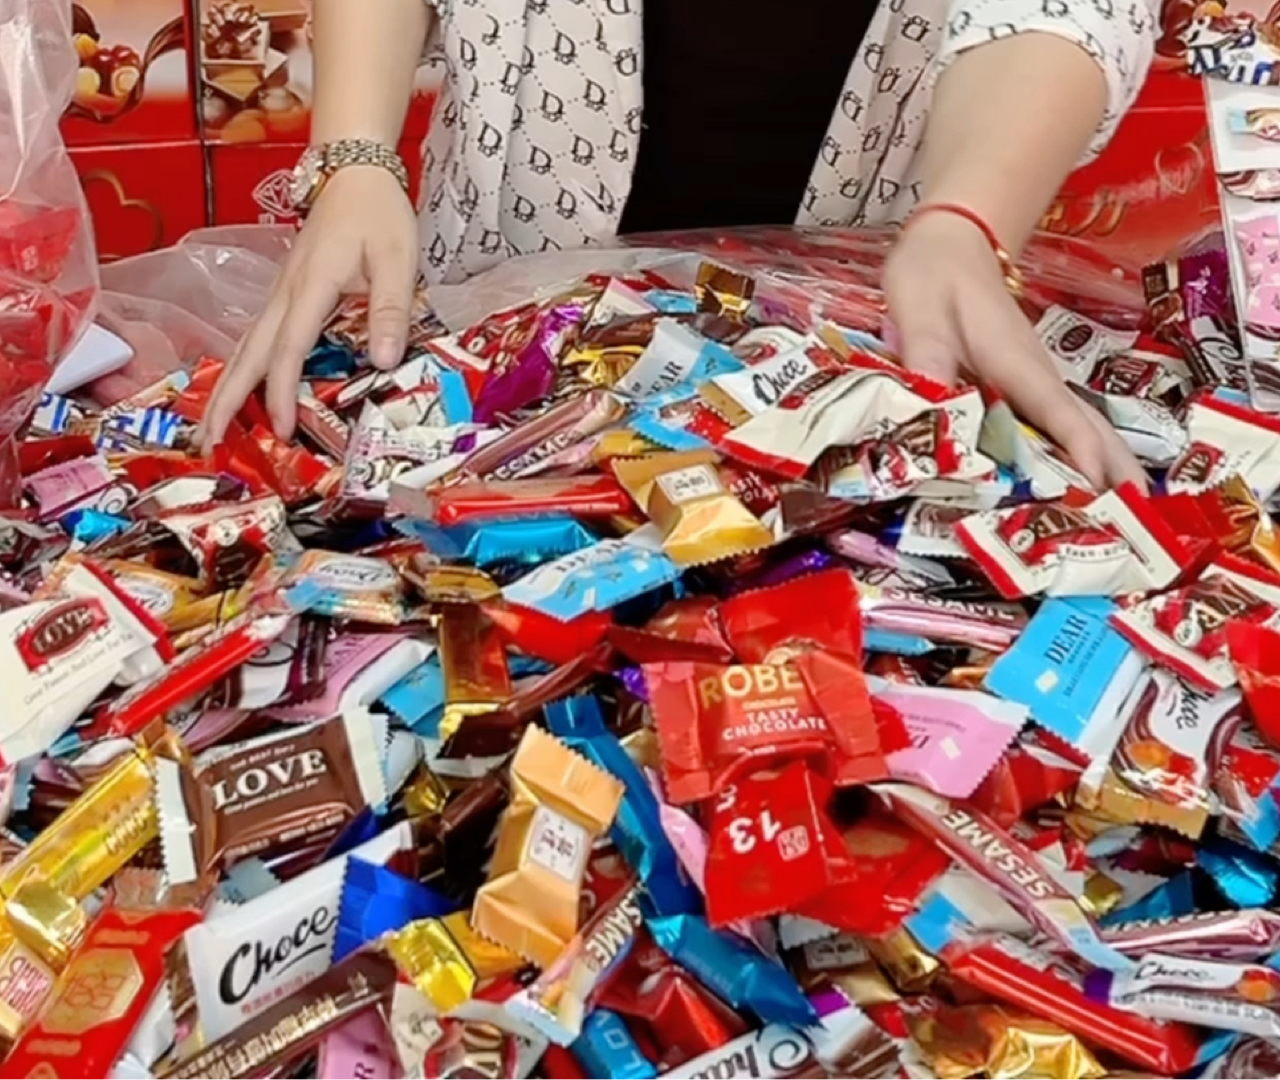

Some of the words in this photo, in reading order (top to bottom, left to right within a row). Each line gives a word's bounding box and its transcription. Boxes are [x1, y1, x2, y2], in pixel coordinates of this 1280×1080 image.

[1043, 614, 1088, 667] DEAR
[722, 718, 826, 742] CHOCOLATE
[746, 707, 799, 724] TASTY
[211, 746, 327, 810] LOVE
[942, 809, 1054, 899] SESAME
